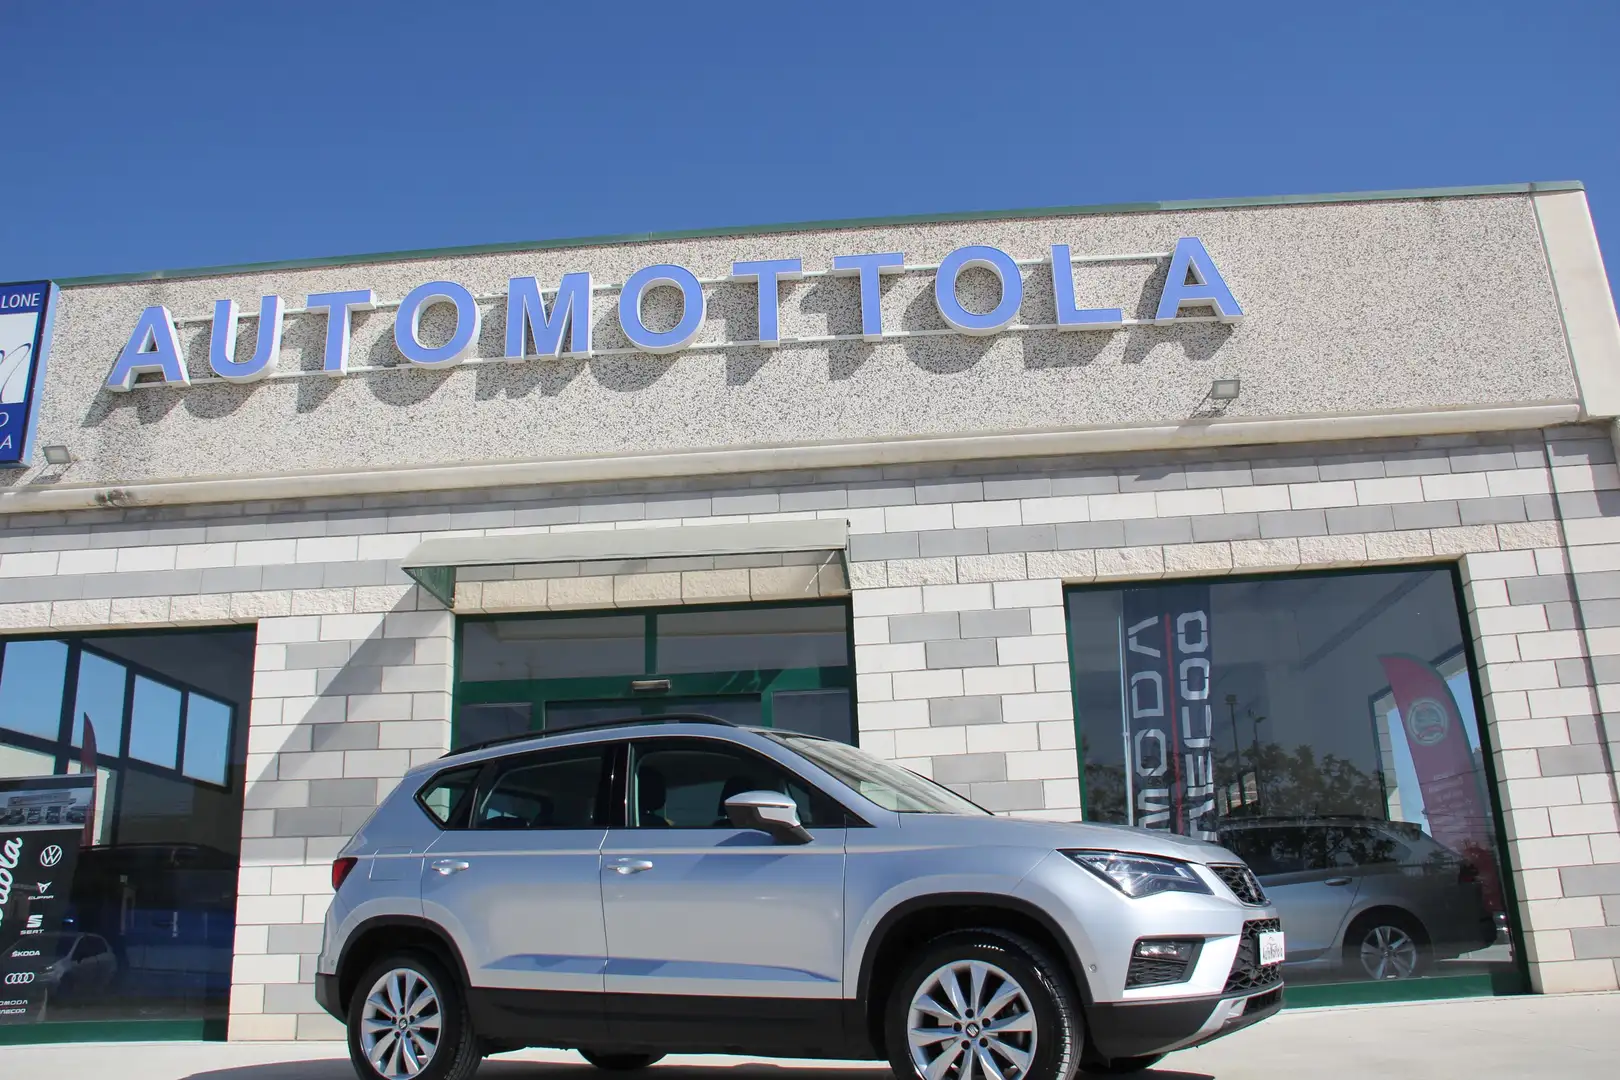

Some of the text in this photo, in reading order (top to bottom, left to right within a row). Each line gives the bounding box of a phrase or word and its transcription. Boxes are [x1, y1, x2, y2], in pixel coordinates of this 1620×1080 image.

[1, 292, 41, 309] LONE
[106, 237, 1244, 393] AUTOMOTTOLA
[20, 928, 45, 936] SEAT
